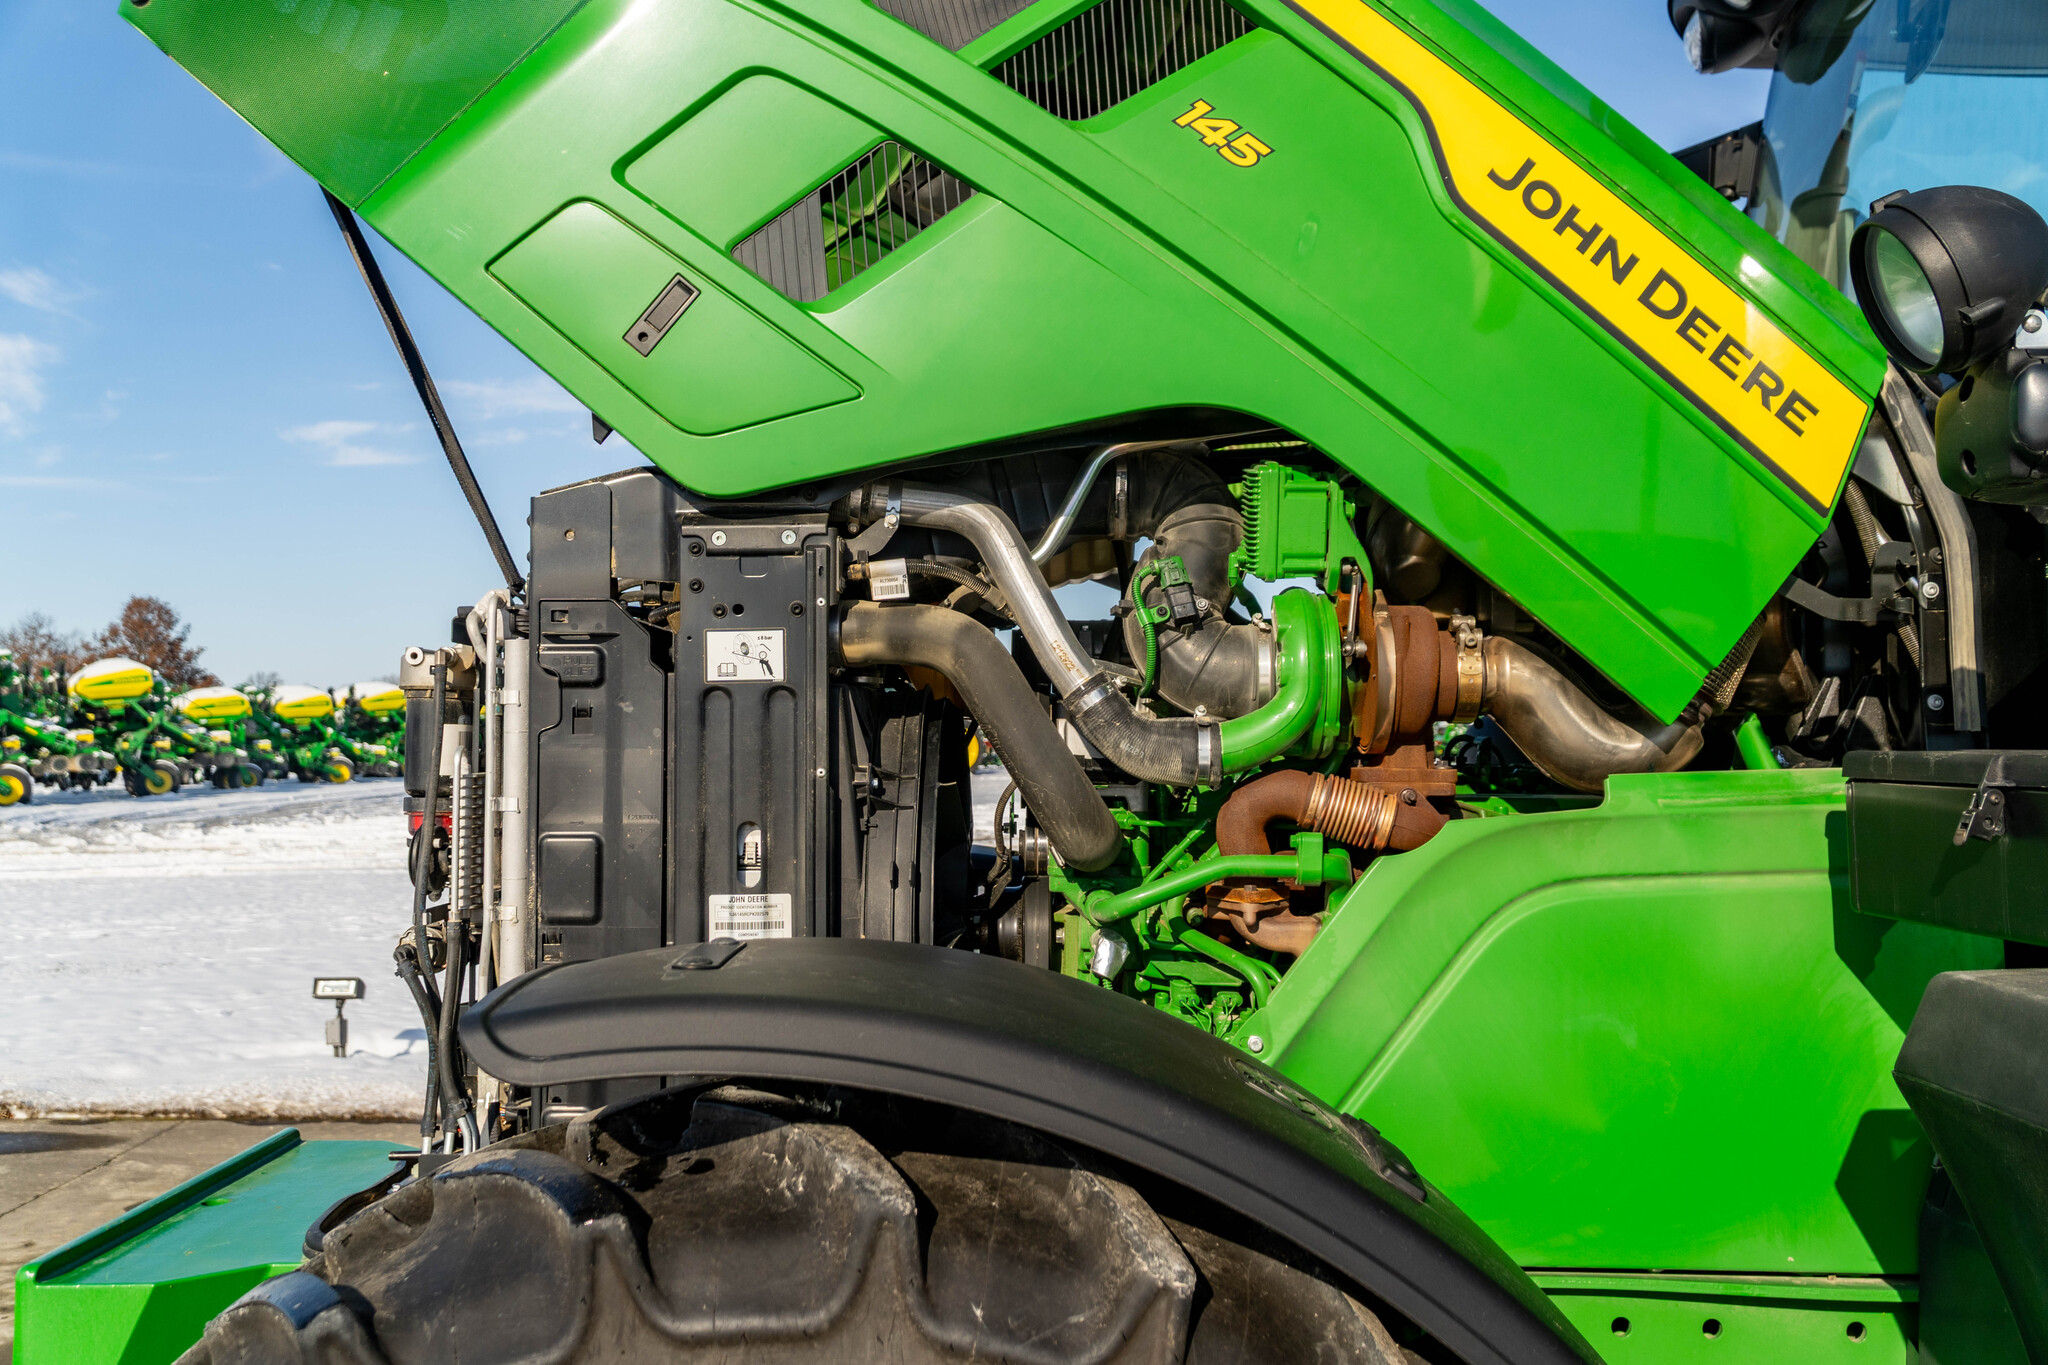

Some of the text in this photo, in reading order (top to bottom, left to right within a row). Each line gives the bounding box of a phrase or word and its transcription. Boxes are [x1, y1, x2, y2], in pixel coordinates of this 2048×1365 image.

[1172, 98, 1275, 168] 145
[1487, 158, 1820, 437] JOHN DEERE
[563, 655, 596, 666] PULL
